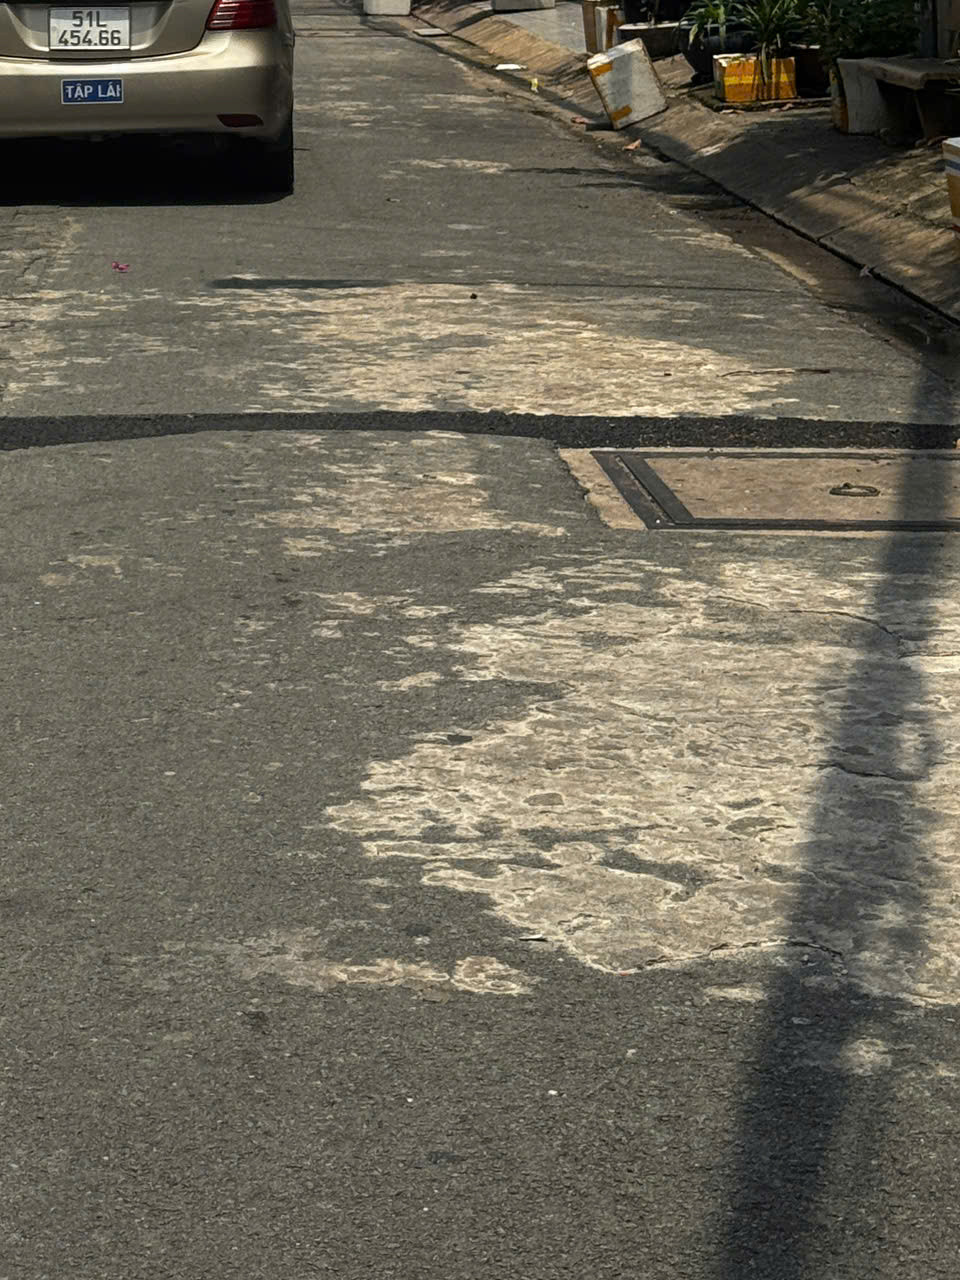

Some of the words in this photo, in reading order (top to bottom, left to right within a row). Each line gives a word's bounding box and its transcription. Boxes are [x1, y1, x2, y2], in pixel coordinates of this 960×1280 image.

[71, 10, 107, 27] 51L
[58, 30, 122, 46] 454.66
[65, 83, 93, 101] TẬP
